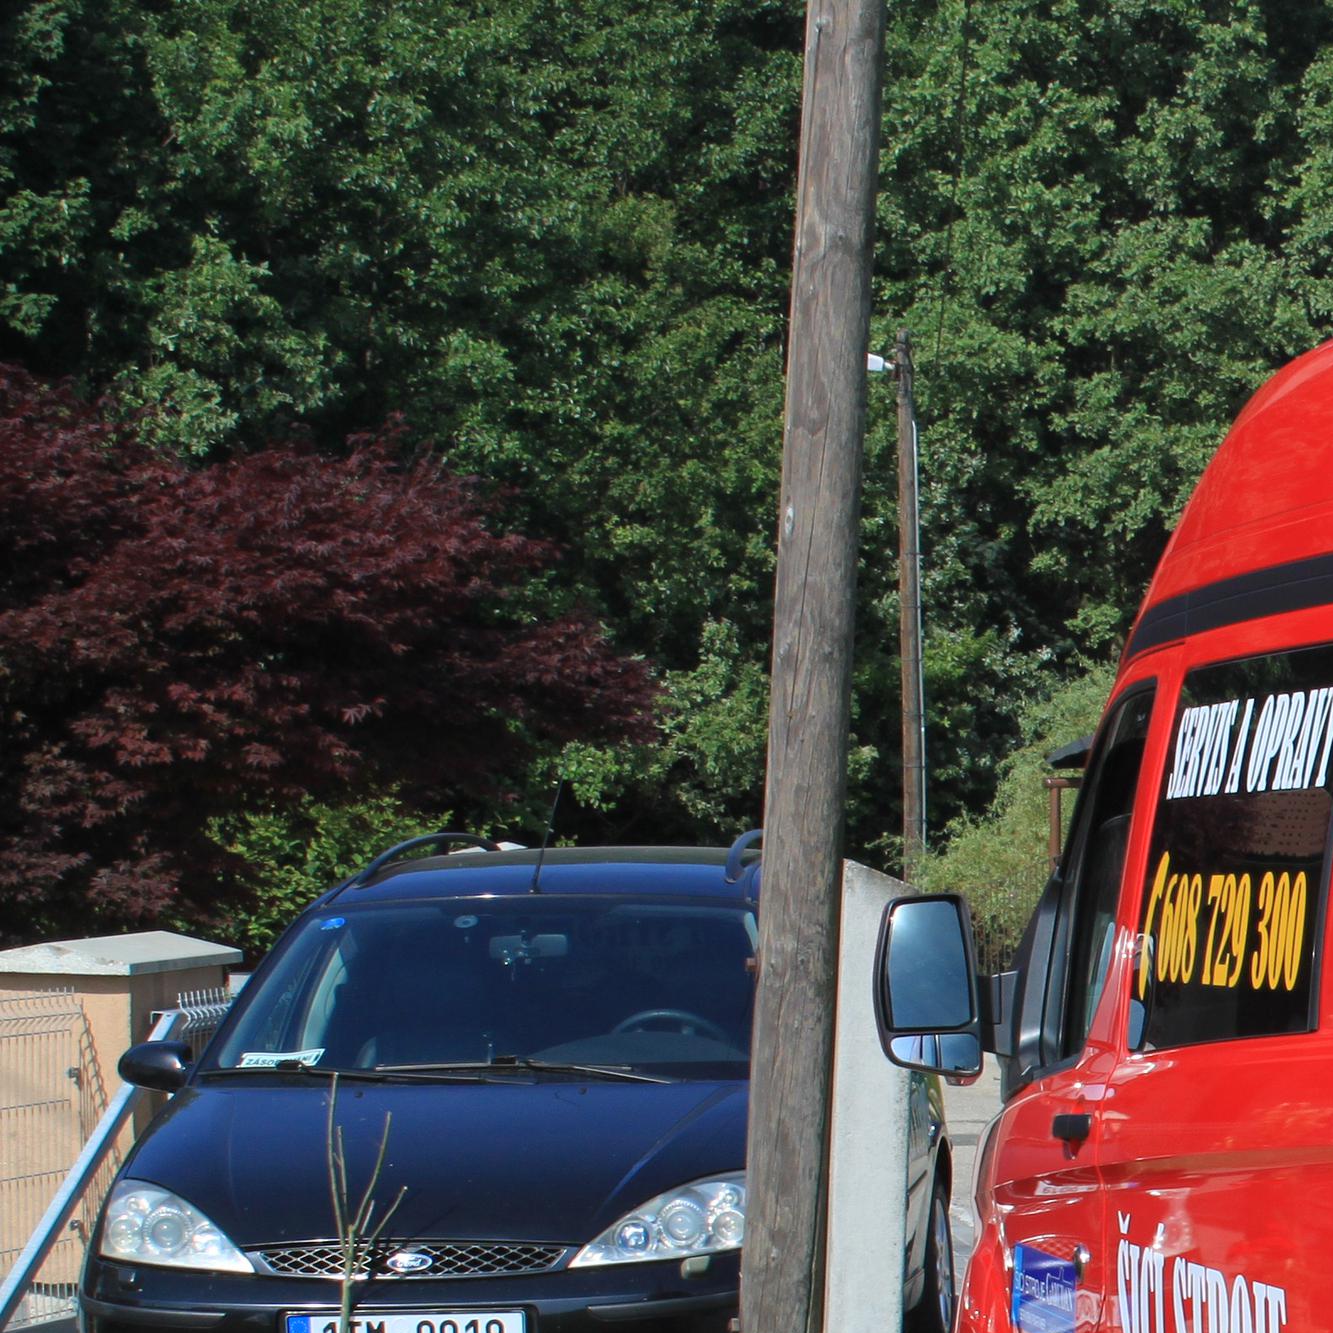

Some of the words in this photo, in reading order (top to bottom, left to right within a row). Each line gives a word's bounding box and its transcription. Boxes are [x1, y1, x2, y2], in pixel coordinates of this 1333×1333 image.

[1166, 699, 1239, 800] SERVIS
[1224, 698, 1255, 794] A
[1157, 873, 1202, 984] 608
[1201, 872, 1251, 989] 729
[1251, 871, 1307, 991] 300
